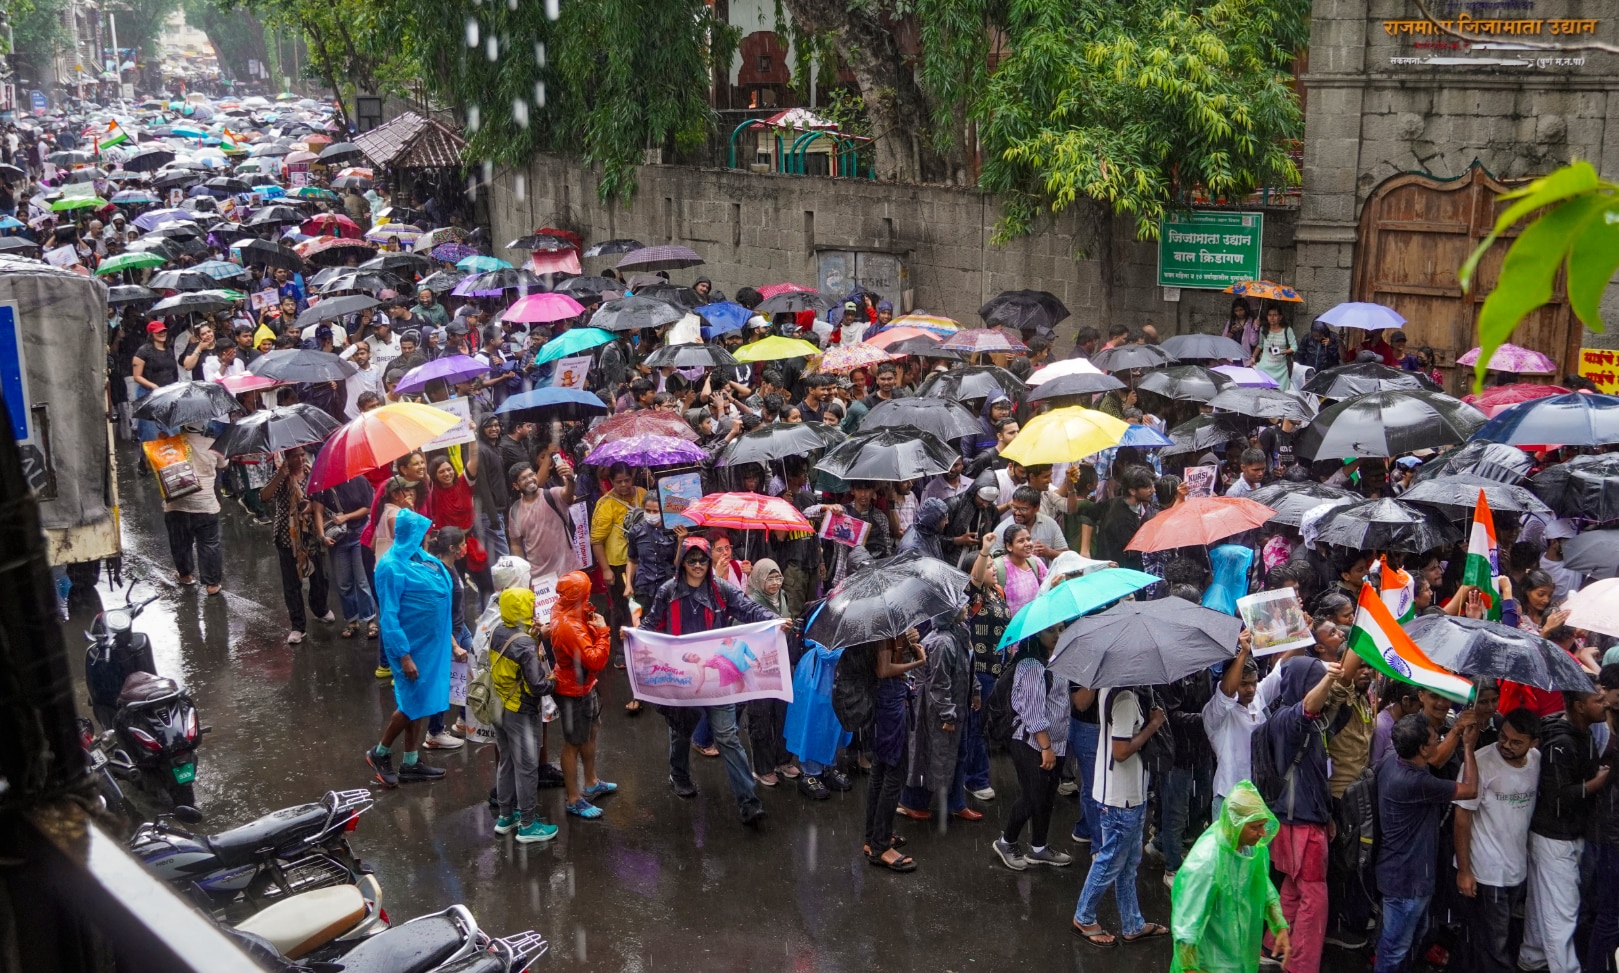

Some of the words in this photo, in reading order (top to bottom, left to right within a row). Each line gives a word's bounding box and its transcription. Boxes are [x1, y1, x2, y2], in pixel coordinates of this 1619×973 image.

[1456, 12, 1544, 35] जिजामाता
[1547, 19, 1598, 35] उद्यान
[1168, 229, 1220, 245] जिजामाता
[1223, 233, 1252, 246] उद्यान
[1173, 251, 1196, 262] बाल
[1199, 248, 1244, 264] क्रिडांगण
[1188, 471, 1208, 482] KURSI
